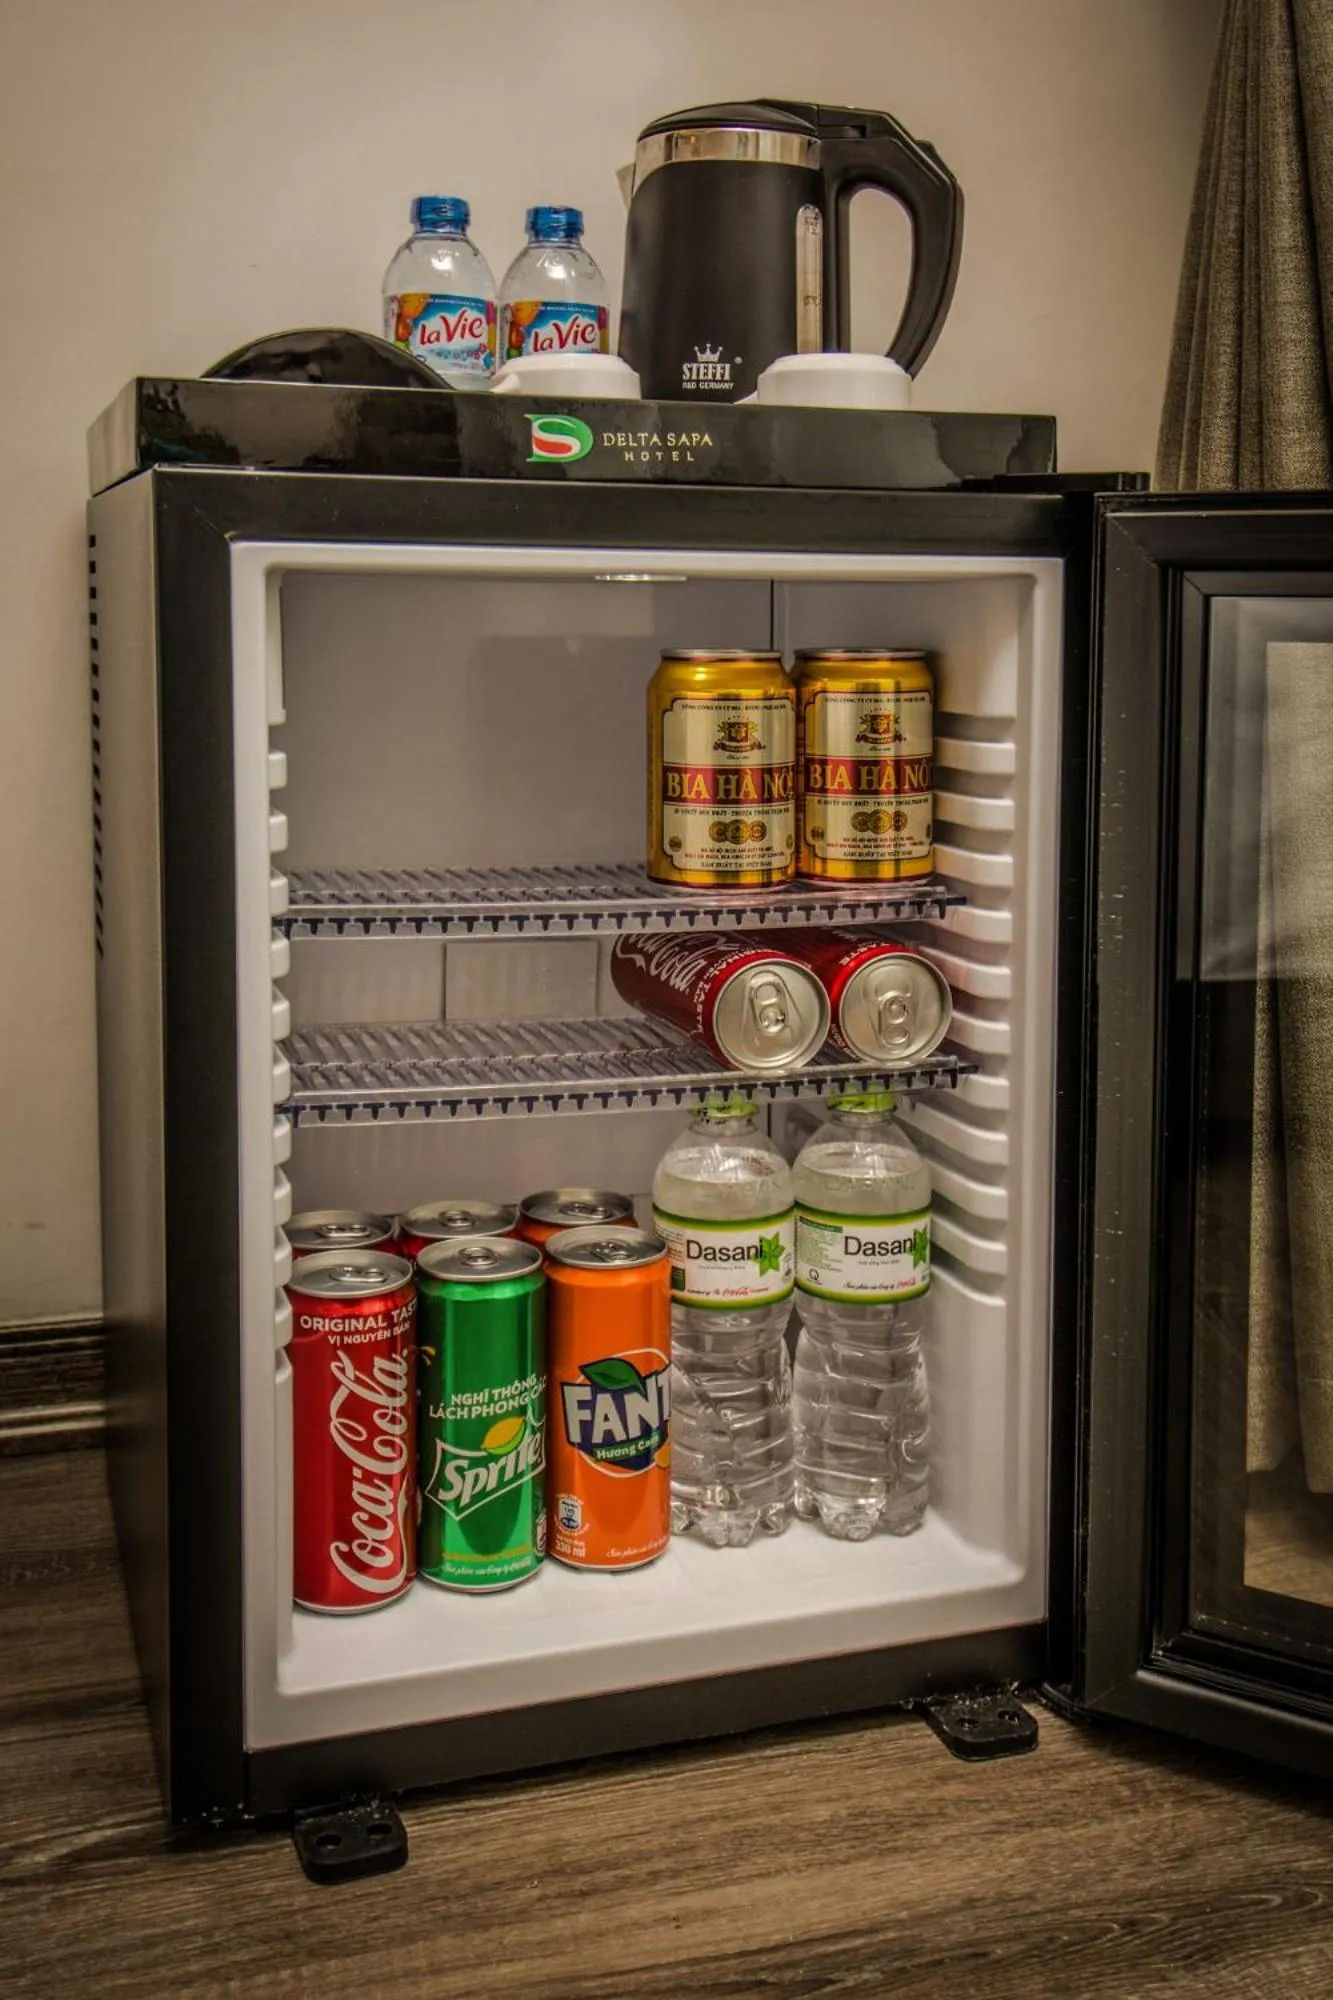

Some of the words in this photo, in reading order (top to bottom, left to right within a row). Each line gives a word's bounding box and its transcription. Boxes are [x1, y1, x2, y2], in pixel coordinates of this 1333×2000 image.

[682, 363, 731, 381] STEFFI
[699, 382, 734, 390] GERMANY
[603, 432, 662, 448] DELTA
[667, 432, 714, 447] SAPA
[624, 451, 695, 462] HOTEL
[666, 771, 711, 800] BIA
[716, 767, 758, 800] HÀ
[809, 763, 853, 791] BIA
[858, 759, 898, 791] HÀ
[685, 1238, 764, 1261] Dasani
[844, 1229, 917, 1257] Dasani
[299, 1314, 388, 1332] ORIGINAL
[327, 1335, 341, 1347] VỊ
[343, 1328, 391, 1345] NGUYÊN
[491, 1373, 537, 1401] THÔNG
[429, 1402, 469, 1420] LÁCH
[471, 1393, 529, 1420] PHONG
[563, 1362, 672, 1444] FANT
[437, 1431, 542, 1508] Sprite
